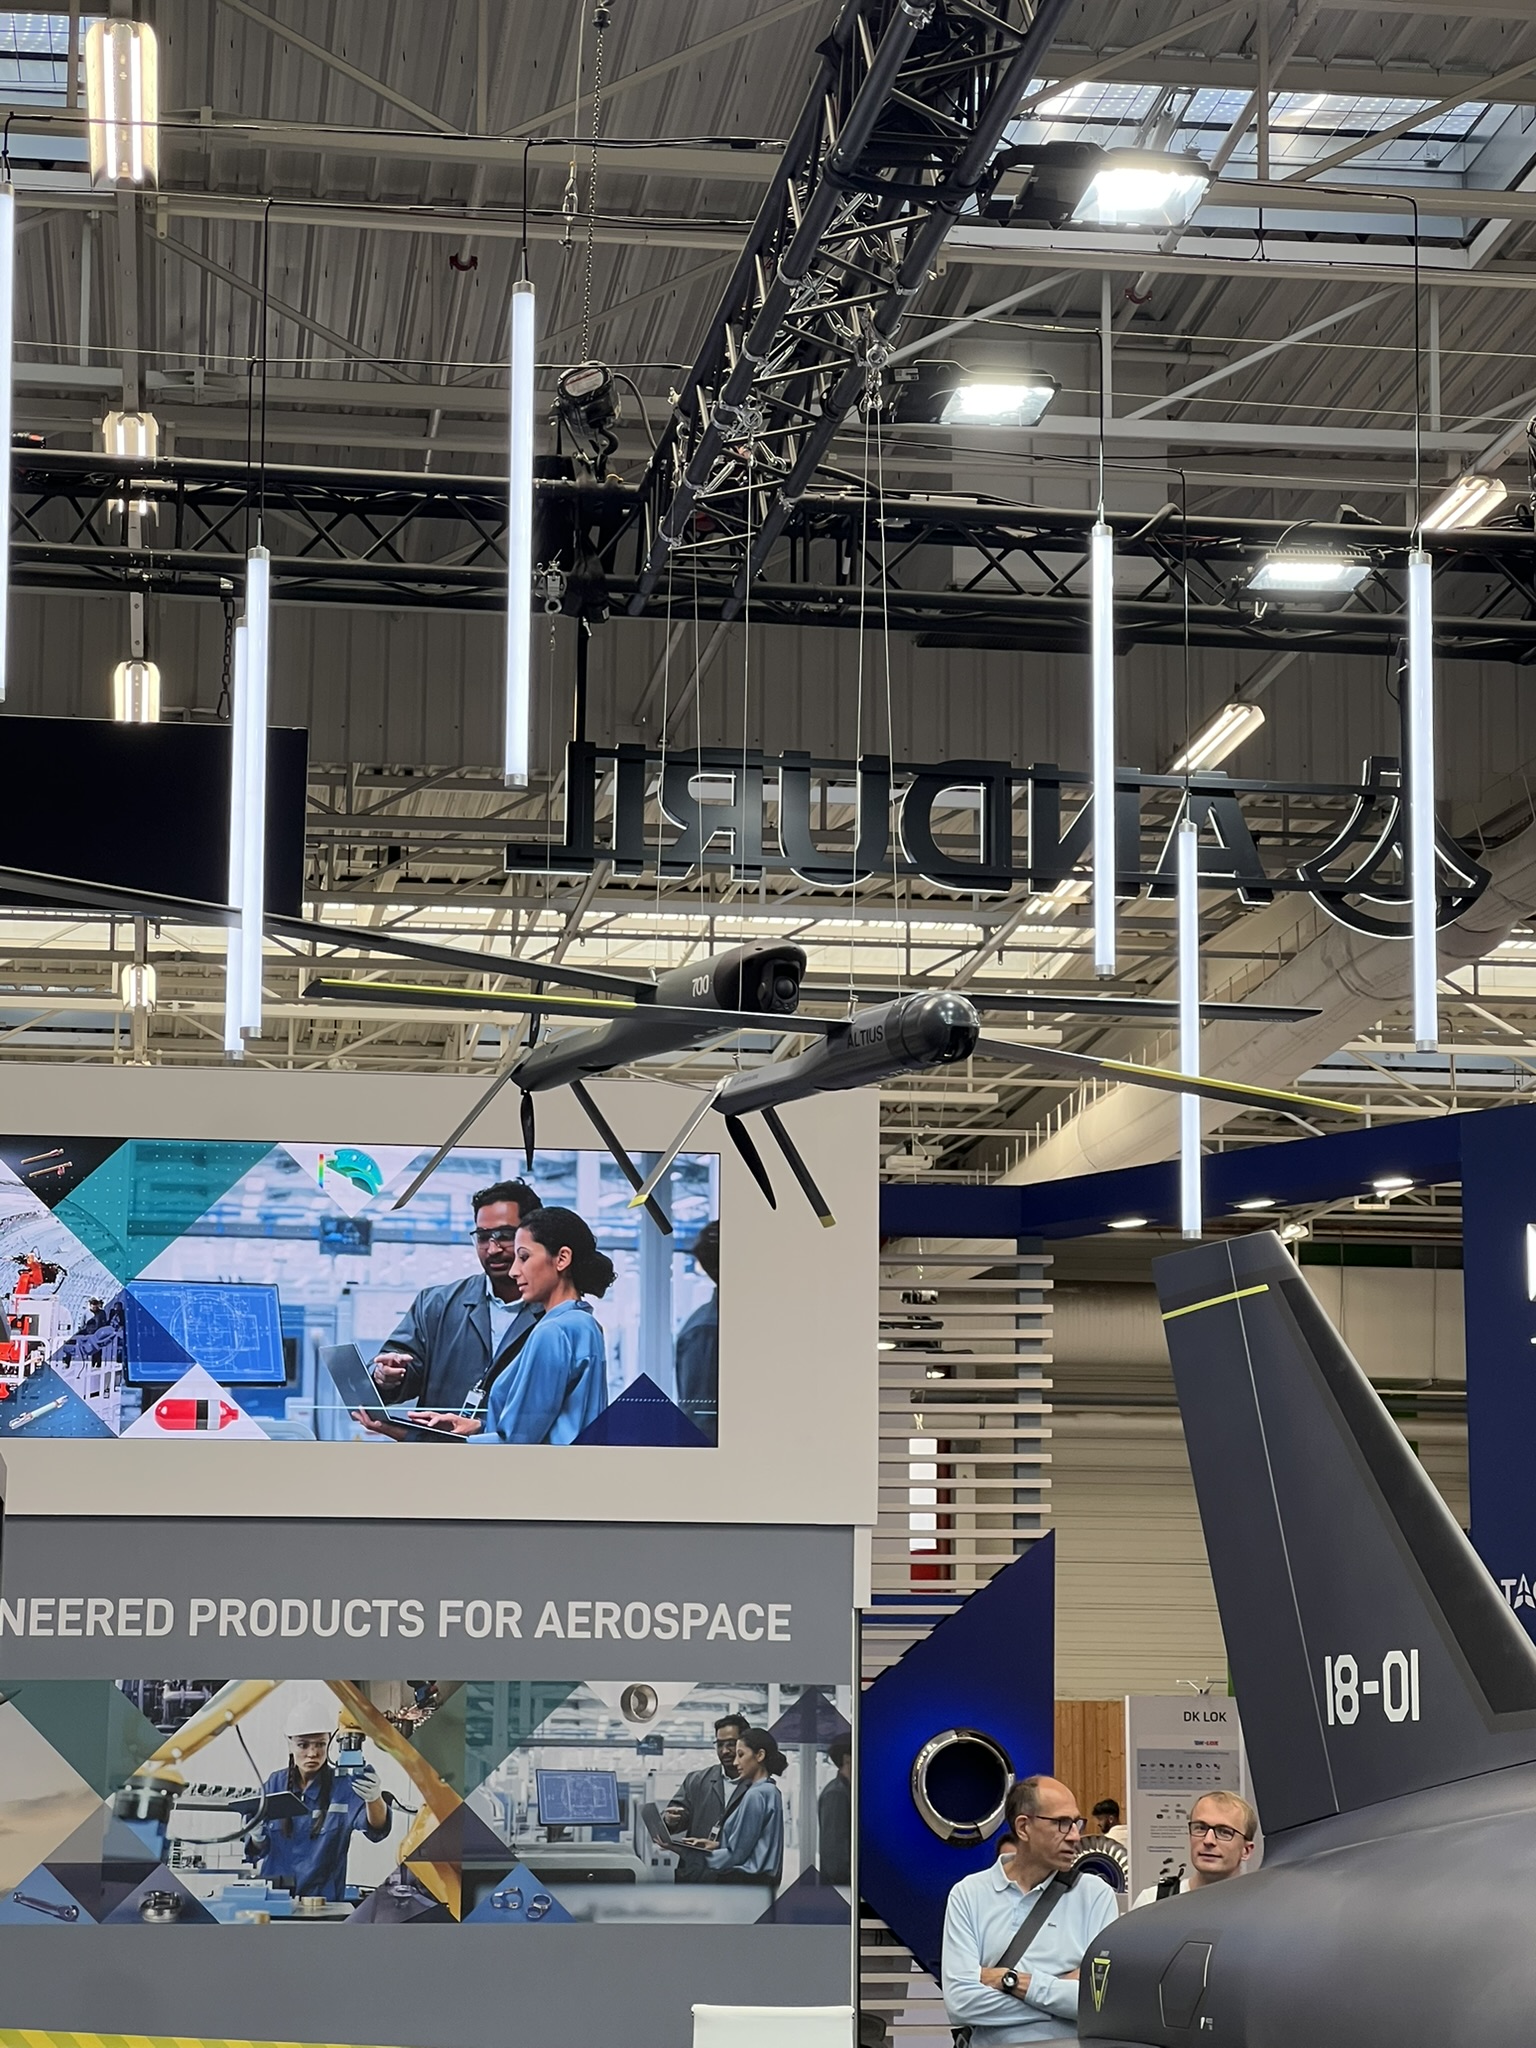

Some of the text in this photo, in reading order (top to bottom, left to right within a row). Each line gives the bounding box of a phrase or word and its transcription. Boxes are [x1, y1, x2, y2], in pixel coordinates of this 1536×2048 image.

[692, 975, 709, 997] 700
[847, 1025, 883, 1049] ALTIUS
[1501, 1573, 1536, 1609] TA
[0, 1598, 792, 1641] NEERED PRODUCTS FOR AEROSPACE
[1325, 1649, 1420, 1725] 18-01
[1183, 1711, 1227, 1722] DK LOK
